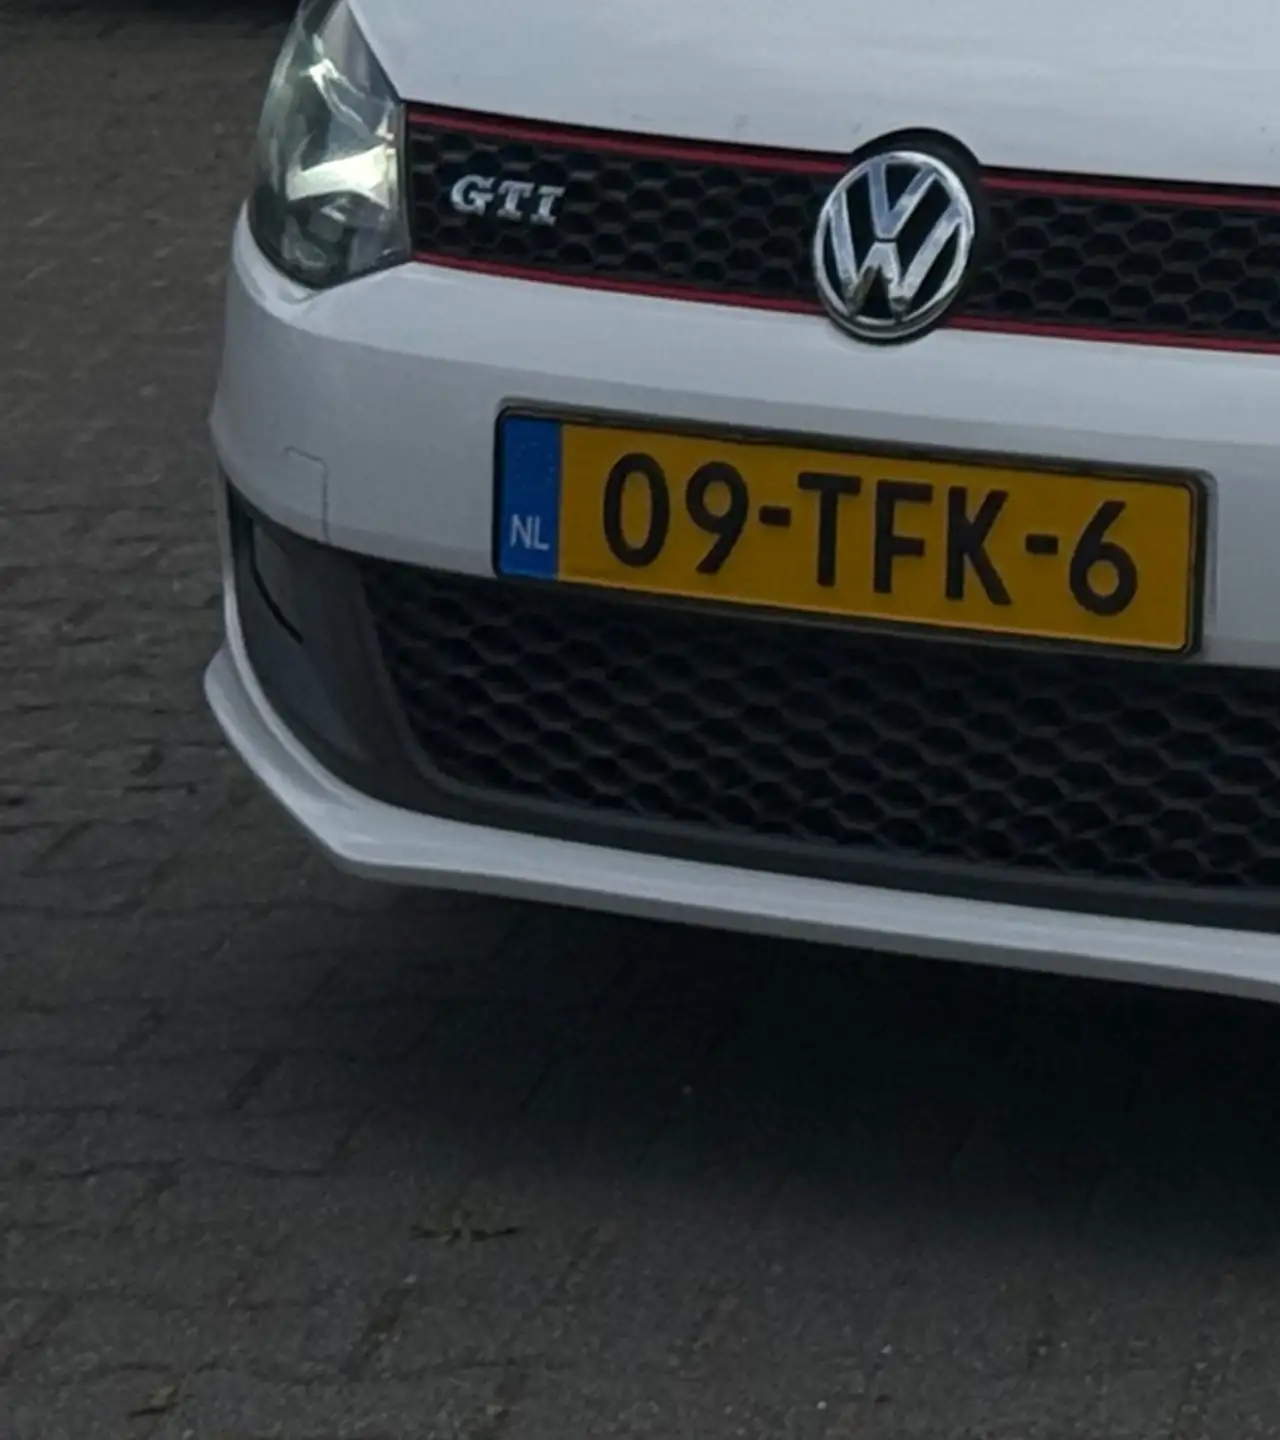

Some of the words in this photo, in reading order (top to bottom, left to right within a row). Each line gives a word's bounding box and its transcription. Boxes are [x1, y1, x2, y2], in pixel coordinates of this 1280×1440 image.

[451, 173, 567, 228] GTI
[509, 512, 552, 554] NL
[602, 452, 1140, 617] 09-TFK-6
